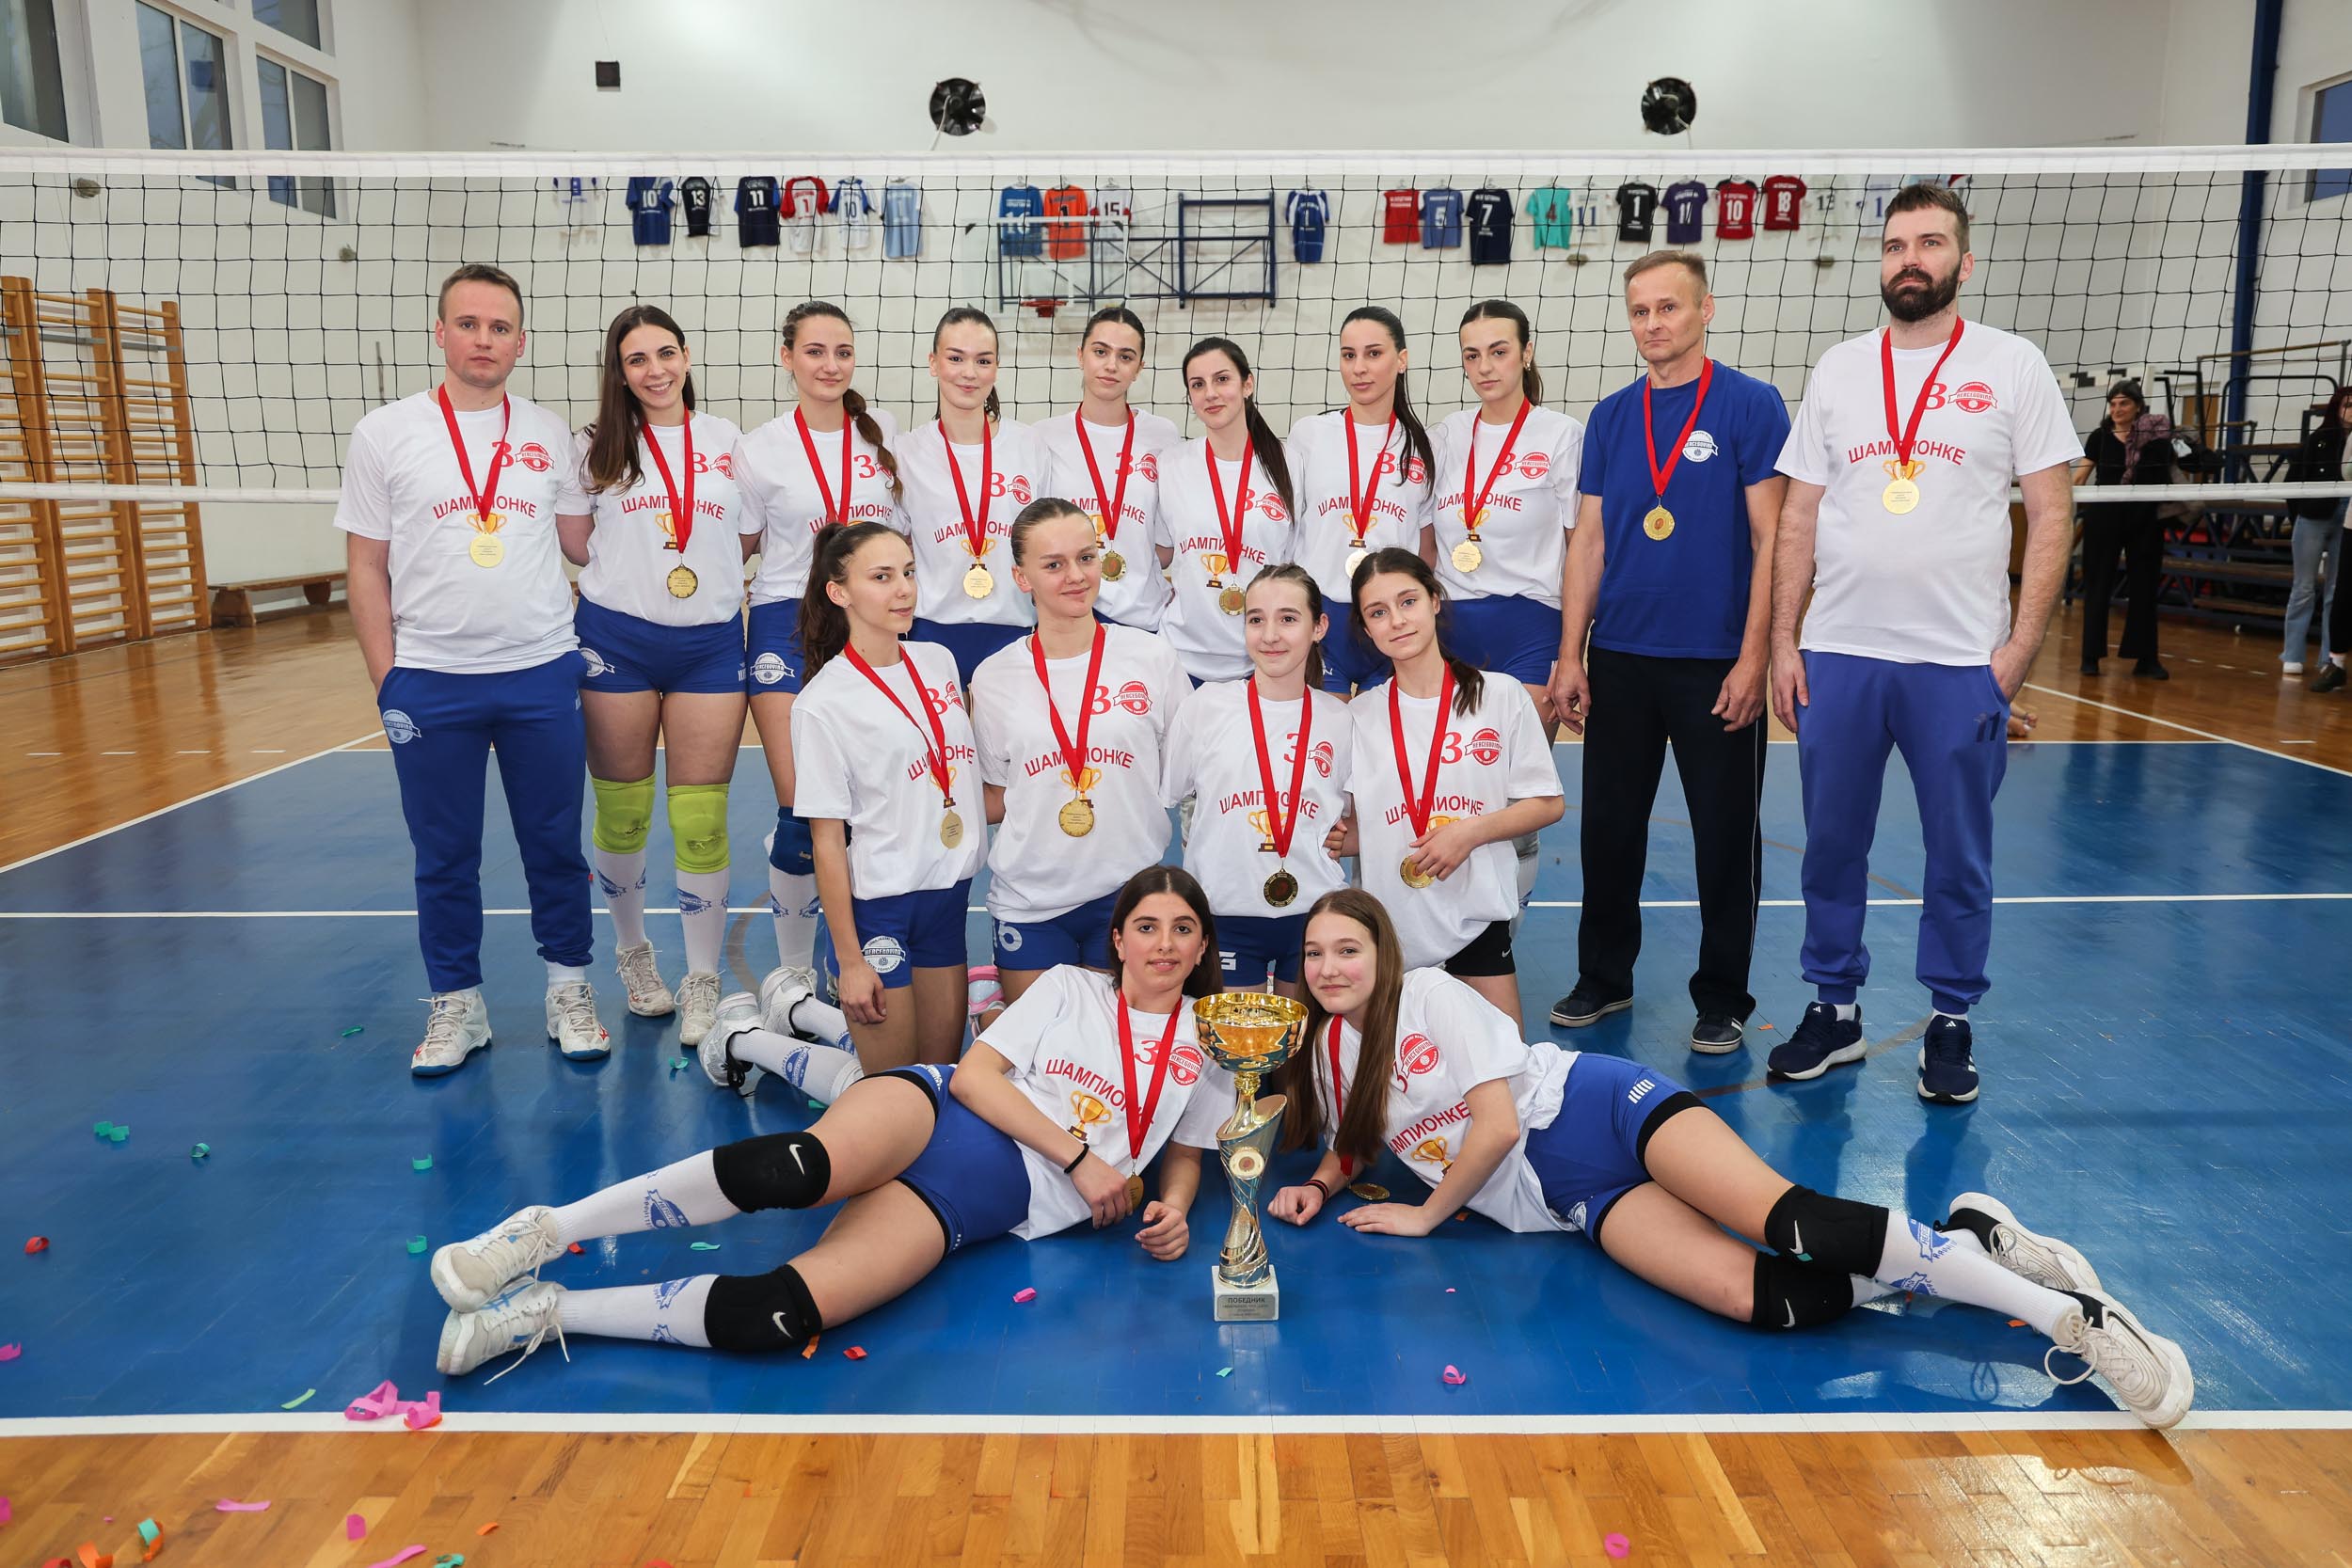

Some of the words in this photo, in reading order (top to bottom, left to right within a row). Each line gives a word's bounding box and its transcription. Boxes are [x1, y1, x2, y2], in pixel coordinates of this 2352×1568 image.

[643, 190, 657, 208] 10
[691, 190, 706, 205] 13
[750, 190, 764, 206] 11
[803, 198, 810, 213] 1
[1633, 196, 1641, 217] 1
[1778, 191, 1792, 213] 18
[1482, 204, 1493, 226] 7
[1726, 200, 1743, 220] 10
[853, 454, 876, 478] 3
[621, 496, 725, 520] ШАМПНКЕ
[1318, 497, 1406, 522] ШАМОНКЕ
[1438, 492, 1522, 512] ШАМОНКЕ
[934, 520, 1013, 543] ШАМОН
[1179, 537, 1265, 565] ШАМПИНКЕ
[1440, 731, 1463, 764] 3
[1025, 747, 1135, 777] ШАМОНКЕ
[1218, 790, 1319, 819] ШАМПОКЕ
[1385, 795, 1485, 825] ШАИОНКЕ
[1170, 1054, 1201, 1074] HERCEGOVIN
[1404, 1040, 1431, 1068] HERCEGOVIN
[1045, 1059, 1154, 1124] ШАМПИО
[1388, 1101, 1471, 1155] АМПИОНКЕ
